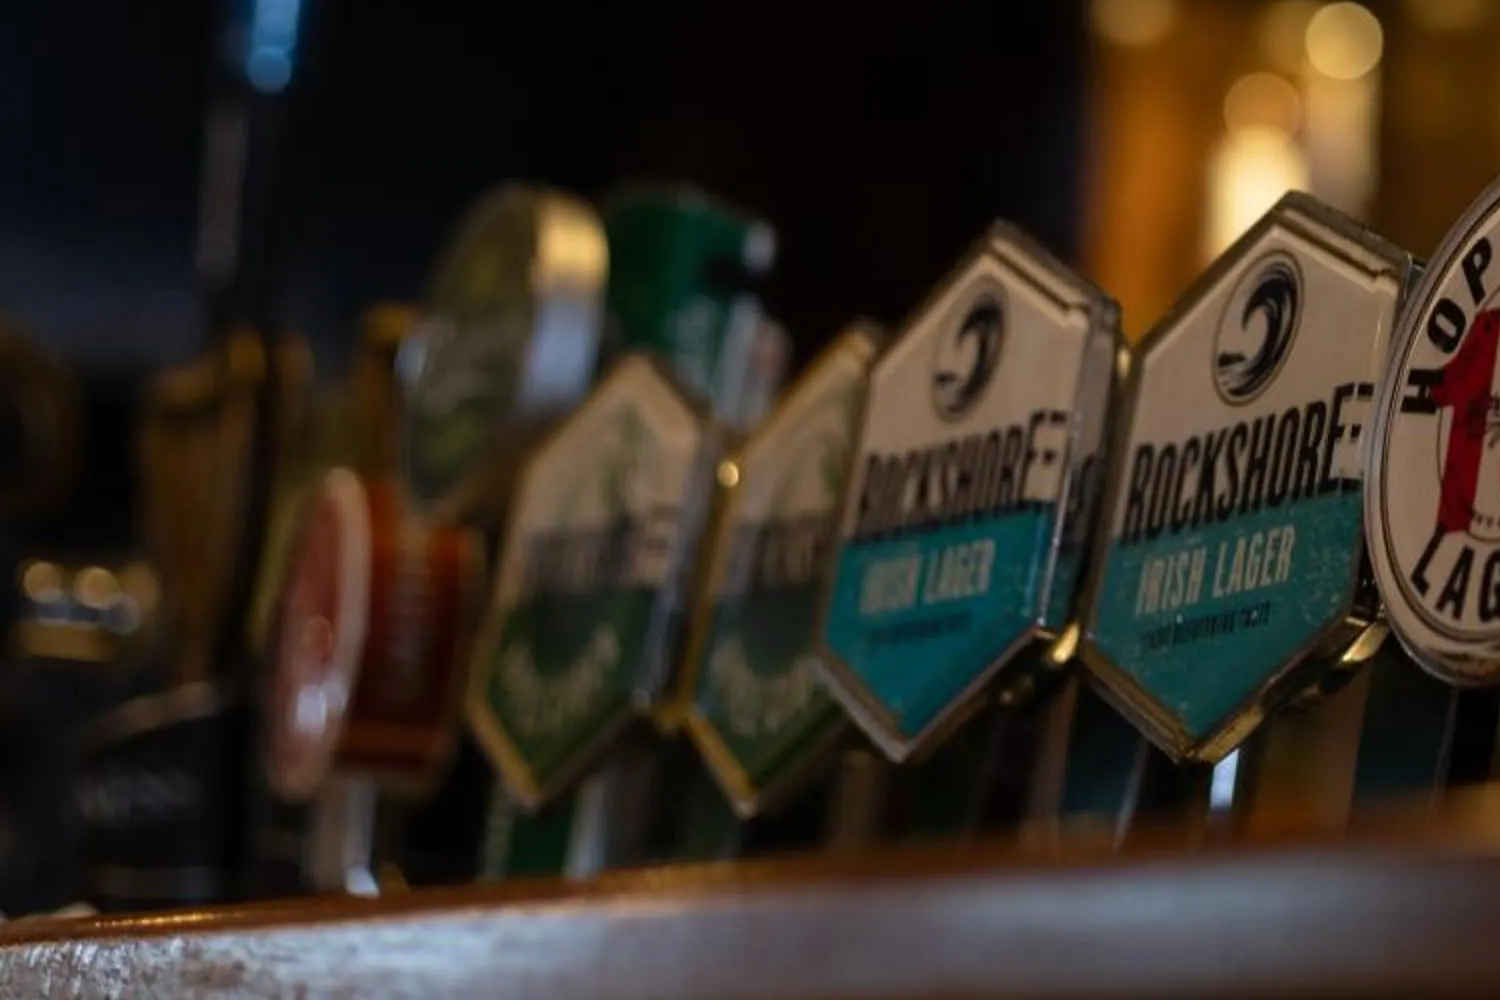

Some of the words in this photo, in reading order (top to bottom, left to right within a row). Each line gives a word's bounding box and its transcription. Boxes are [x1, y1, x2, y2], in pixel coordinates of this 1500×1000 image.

[1400, 236, 1494, 415] HOP
[1120, 383, 1366, 546] ROCKSHORE
[1136, 546, 1206, 616] IRISH
[1211, 523, 1297, 600] LAGER
